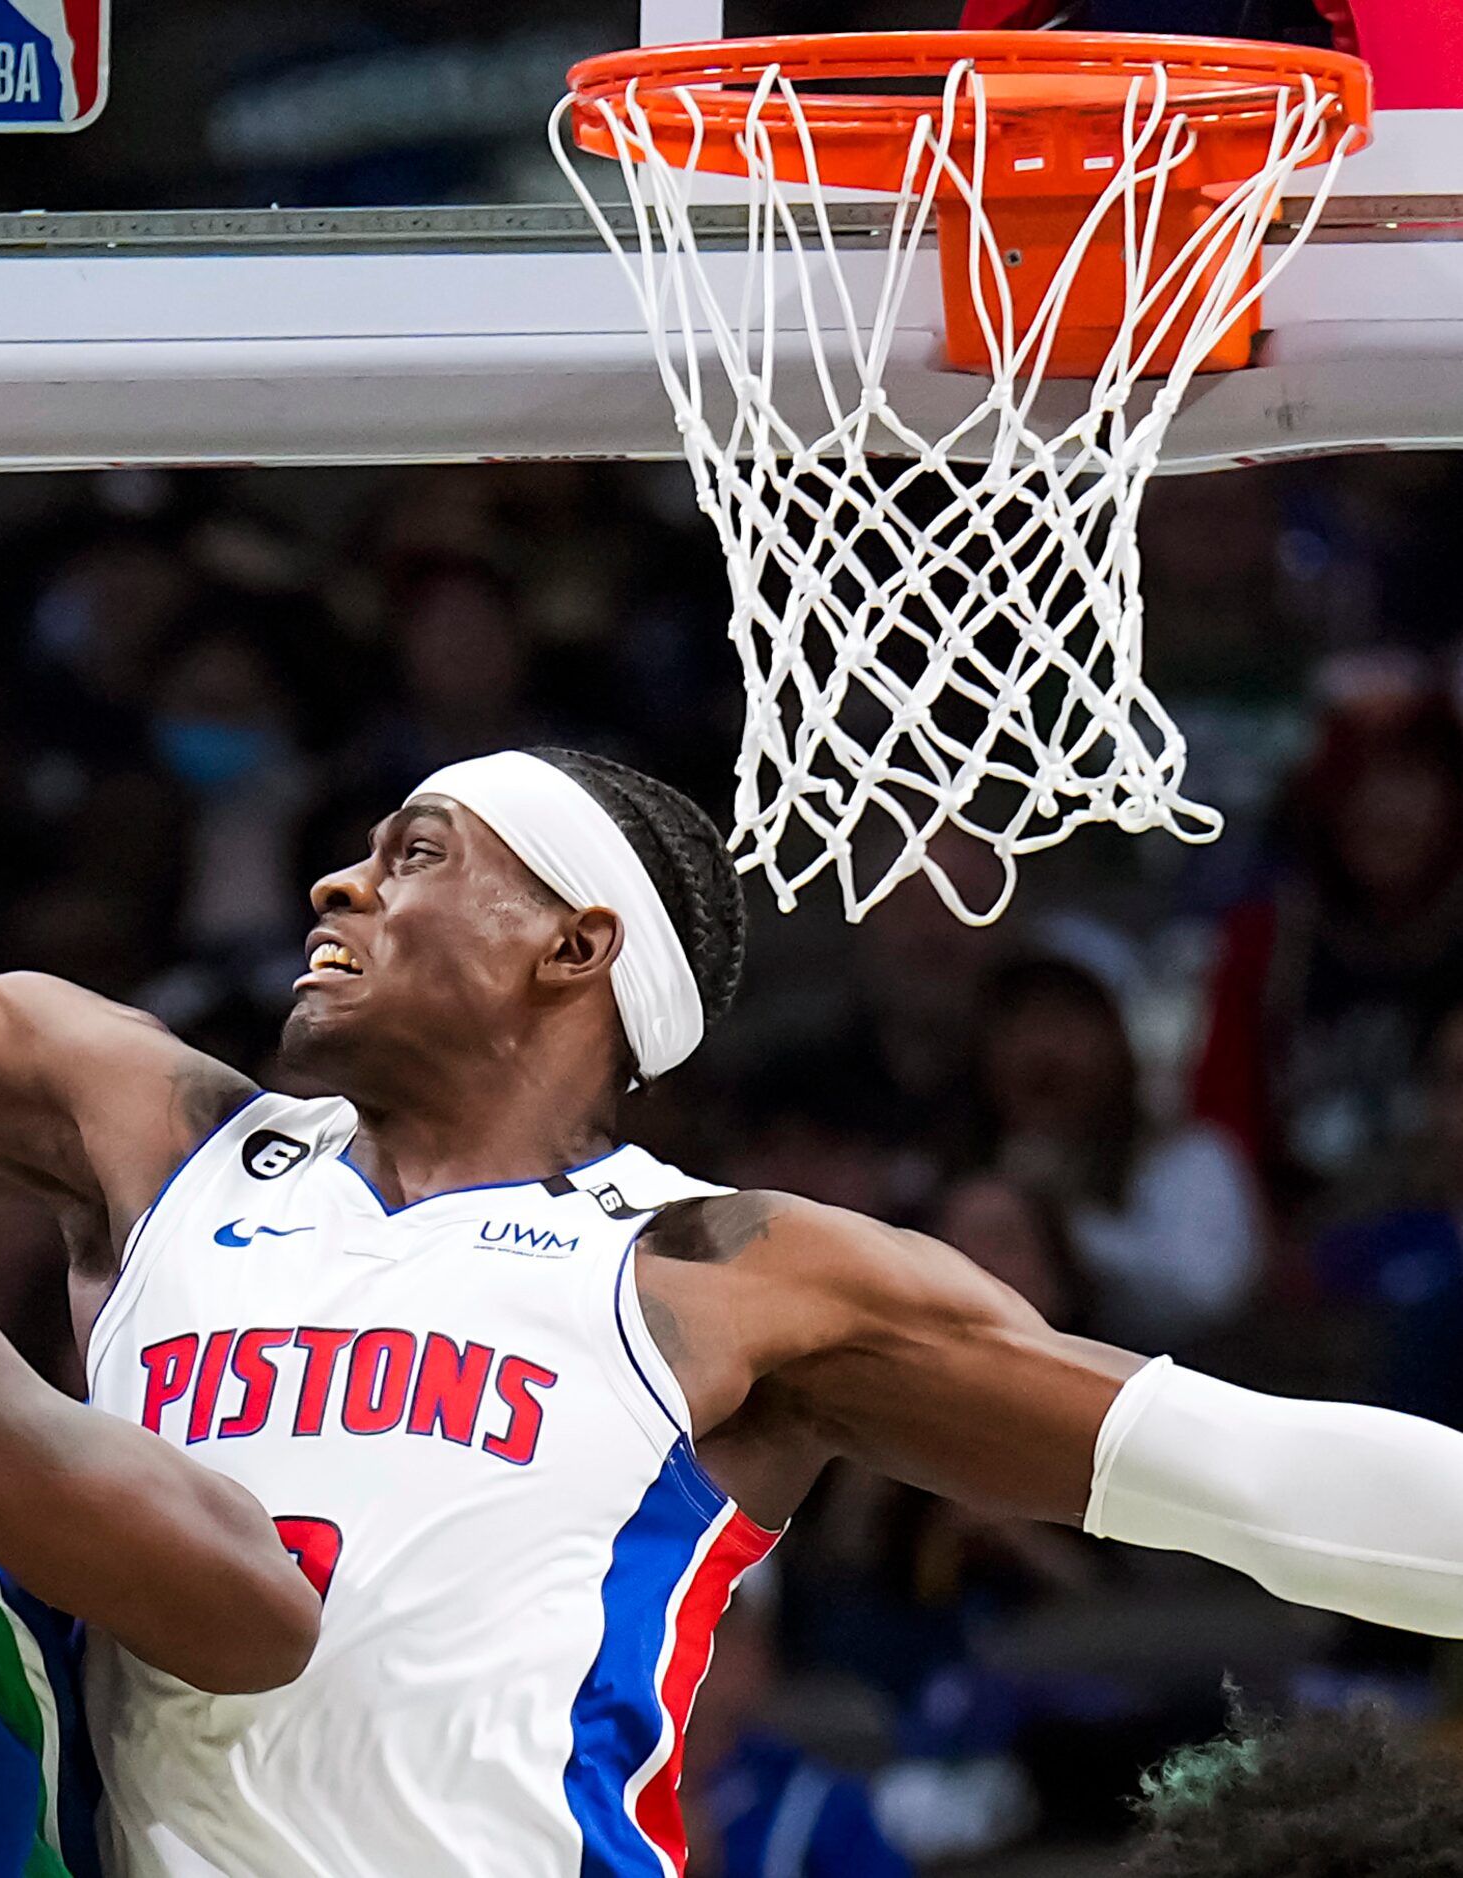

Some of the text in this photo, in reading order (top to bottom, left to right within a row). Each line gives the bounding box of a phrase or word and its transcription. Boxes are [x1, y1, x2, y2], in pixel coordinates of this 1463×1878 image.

[251, 1140, 301, 1177] 6
[480, 1220, 579, 1252] UWM
[141, 1326, 558, 1466] PISTONS
